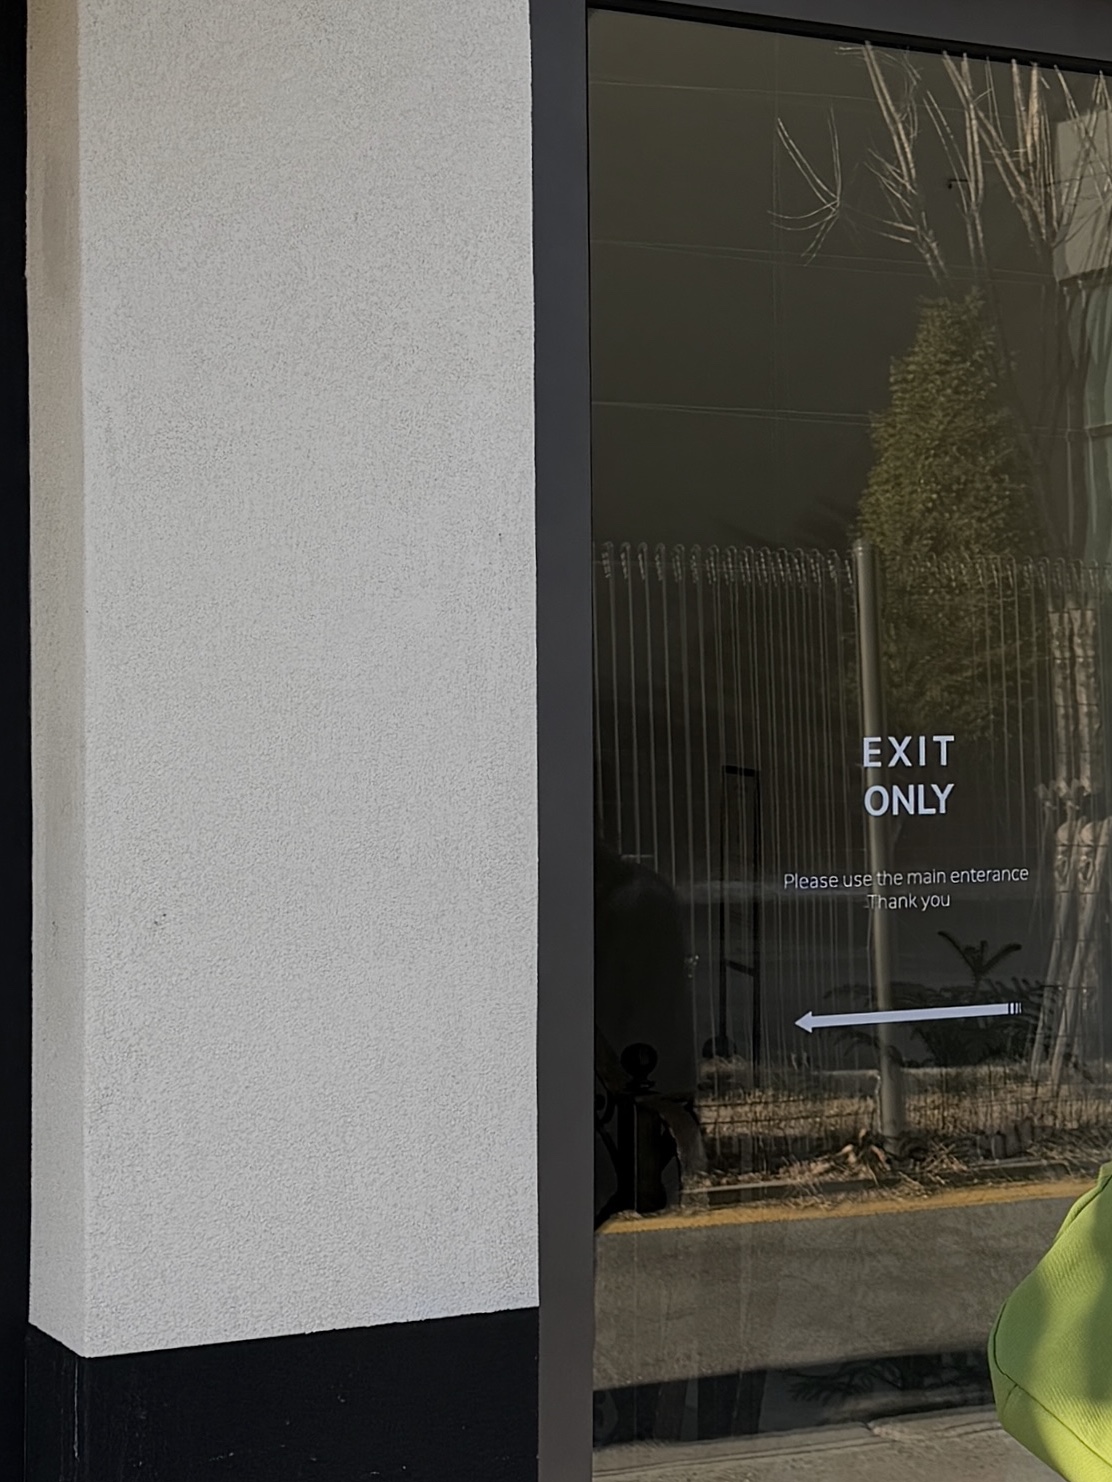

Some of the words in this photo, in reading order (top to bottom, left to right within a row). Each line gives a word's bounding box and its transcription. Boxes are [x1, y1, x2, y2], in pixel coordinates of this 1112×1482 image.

[862, 735, 955, 768] EXIT
[863, 783, 955, 816] ONLY
[783, 872, 839, 890] Please
[843, 873, 873, 887] use
[876, 870, 904, 886] the
[907, 868, 947, 885] main
[950, 867, 1030, 884] enterance
[866, 893, 918, 910] Thank
[920, 894, 951, 912] you
